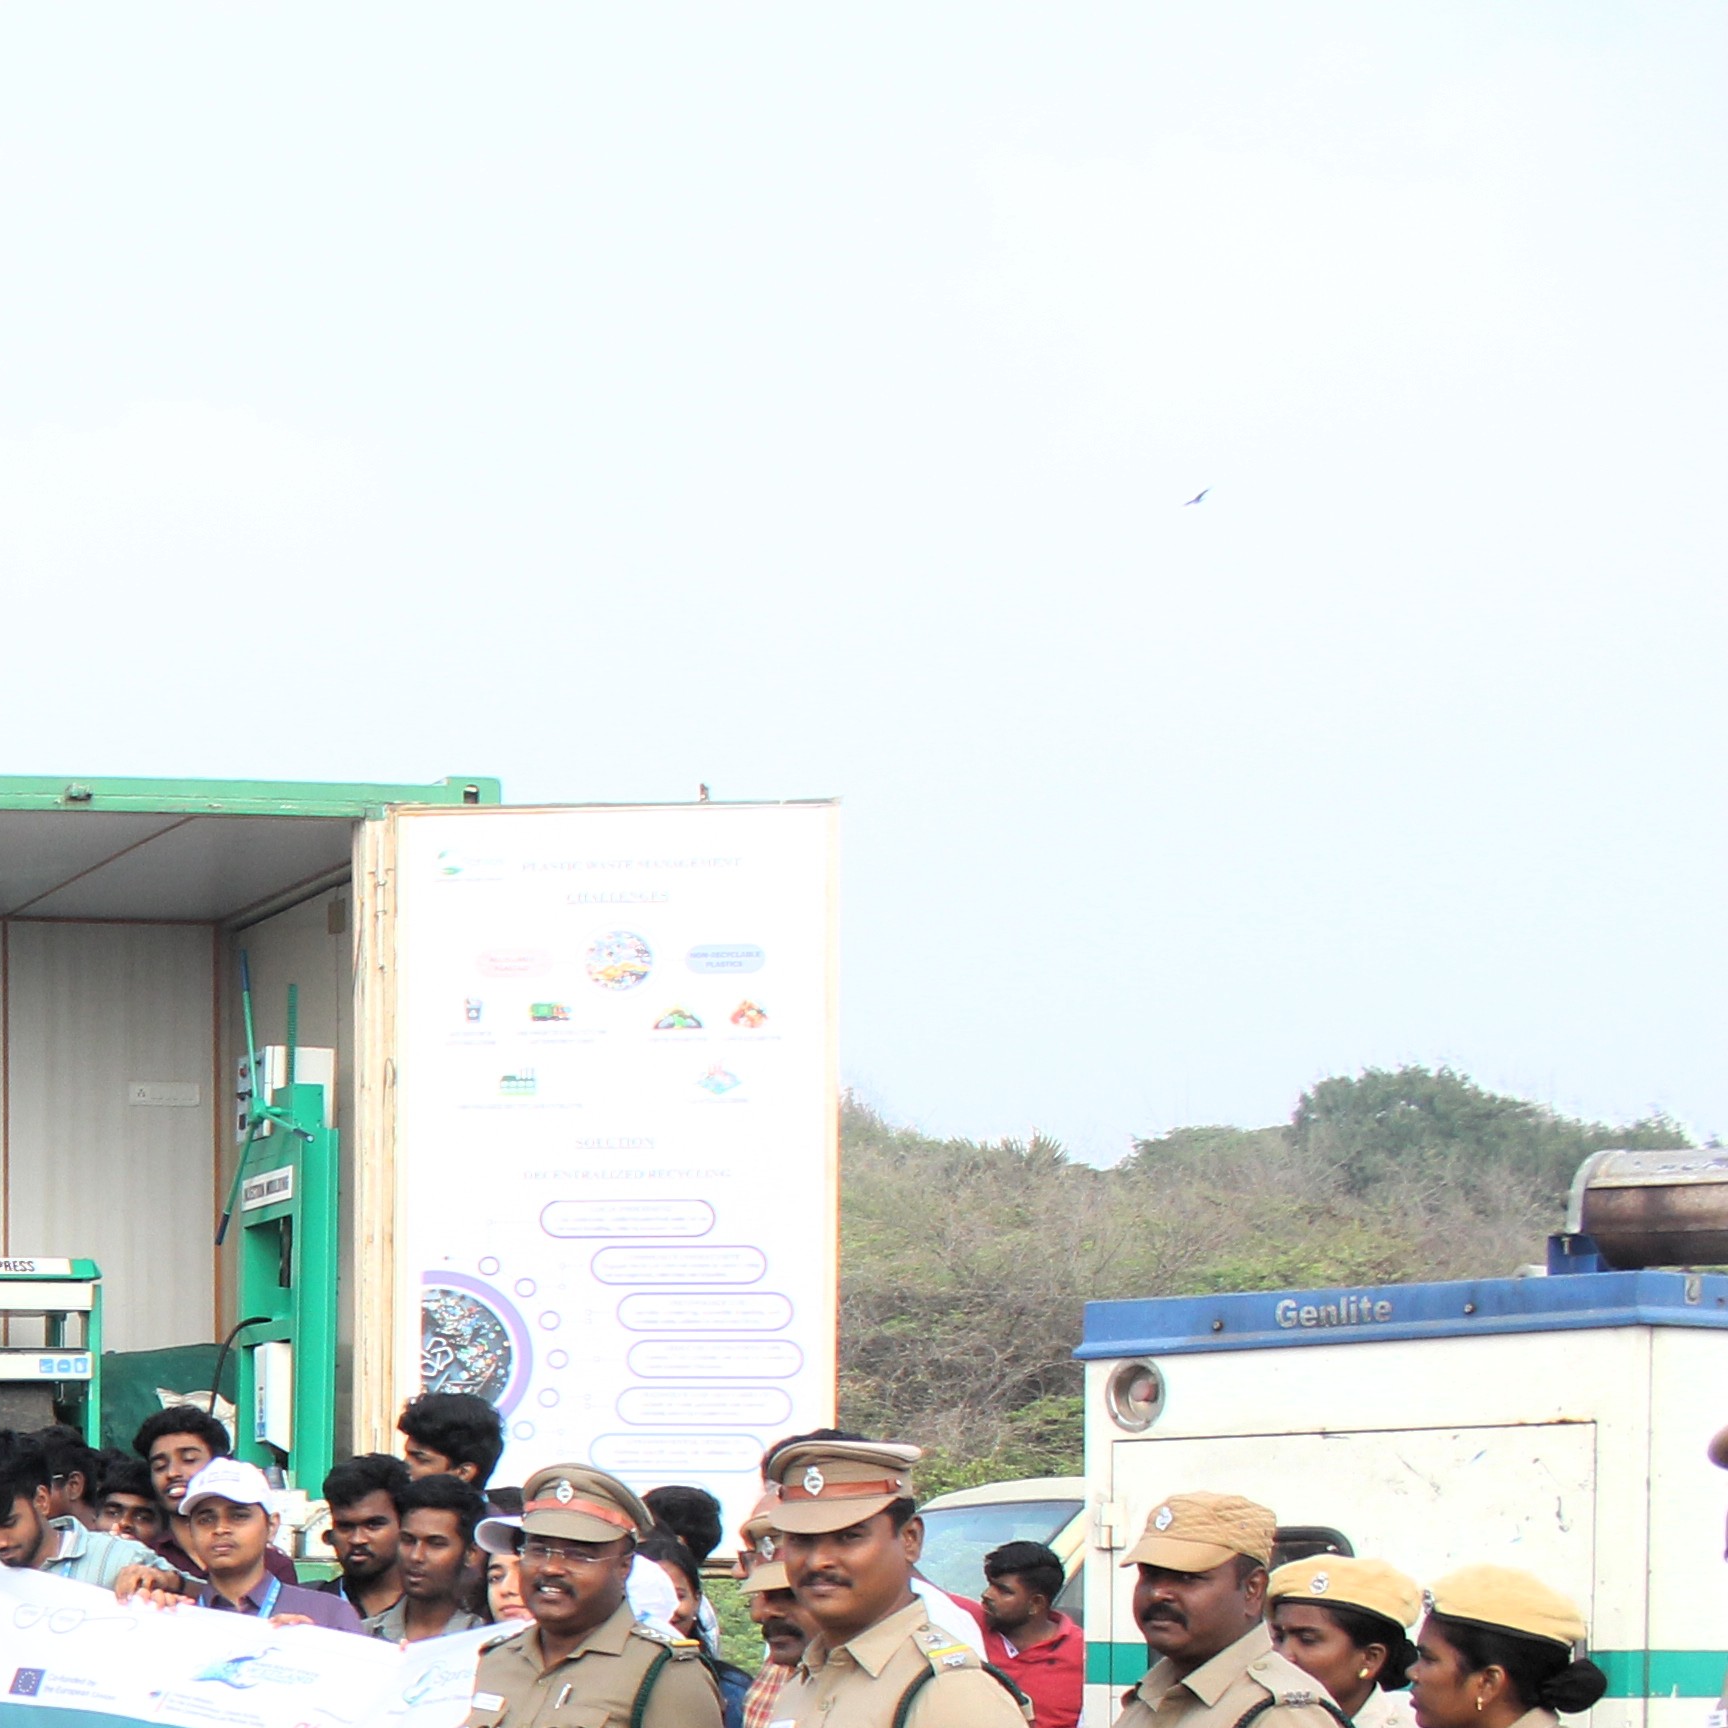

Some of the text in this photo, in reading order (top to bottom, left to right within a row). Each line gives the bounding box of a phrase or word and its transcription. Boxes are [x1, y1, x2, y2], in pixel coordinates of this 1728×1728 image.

[690, 950, 762, 961] NON-RECYCLABLE
[706, 960, 743, 969] PLASTICS
[575, 1136, 656, 1149] SOLUTION
[523, 1168, 732, 1181] DECENTRALIZED RECYCLING
[1274, 1295, 1393, 1330] Genlite
